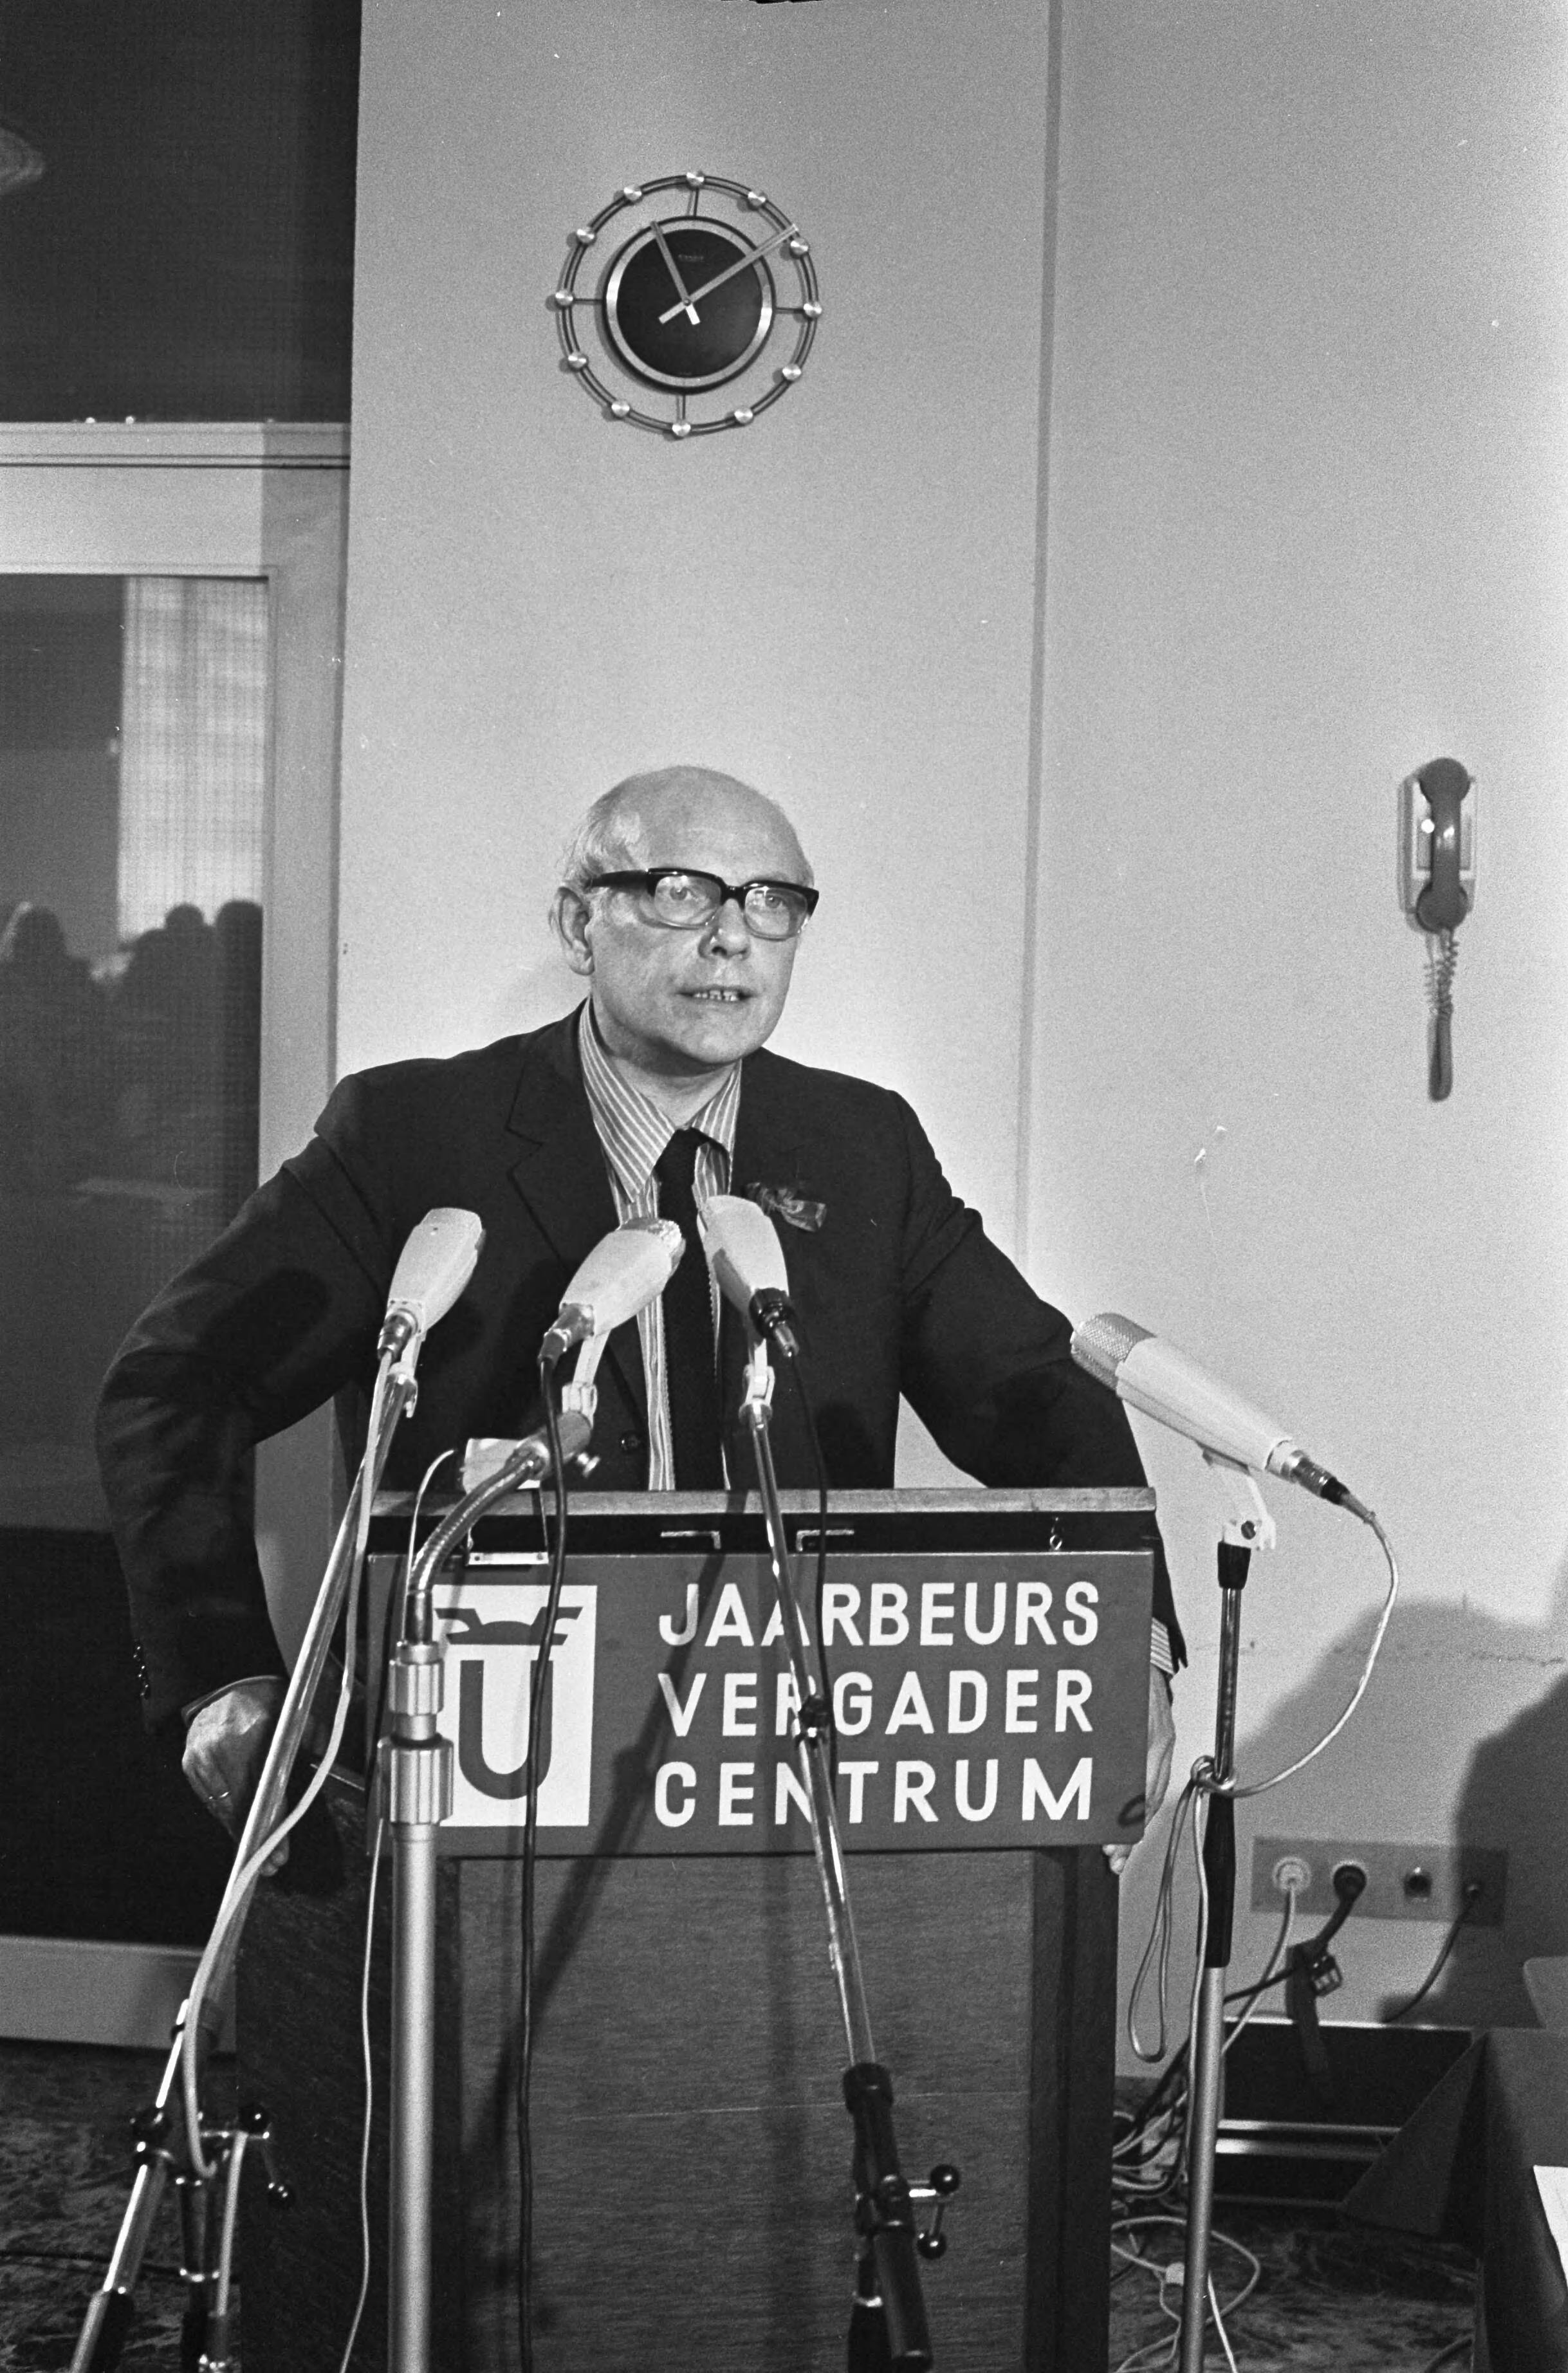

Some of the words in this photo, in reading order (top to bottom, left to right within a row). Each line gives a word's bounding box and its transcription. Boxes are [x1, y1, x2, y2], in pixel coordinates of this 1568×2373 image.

[659, 1582, 1099, 1646] JAARBEURS
[658, 1669, 1094, 1737] VERGADER
[654, 1758, 1093, 1827] CENTRUM
